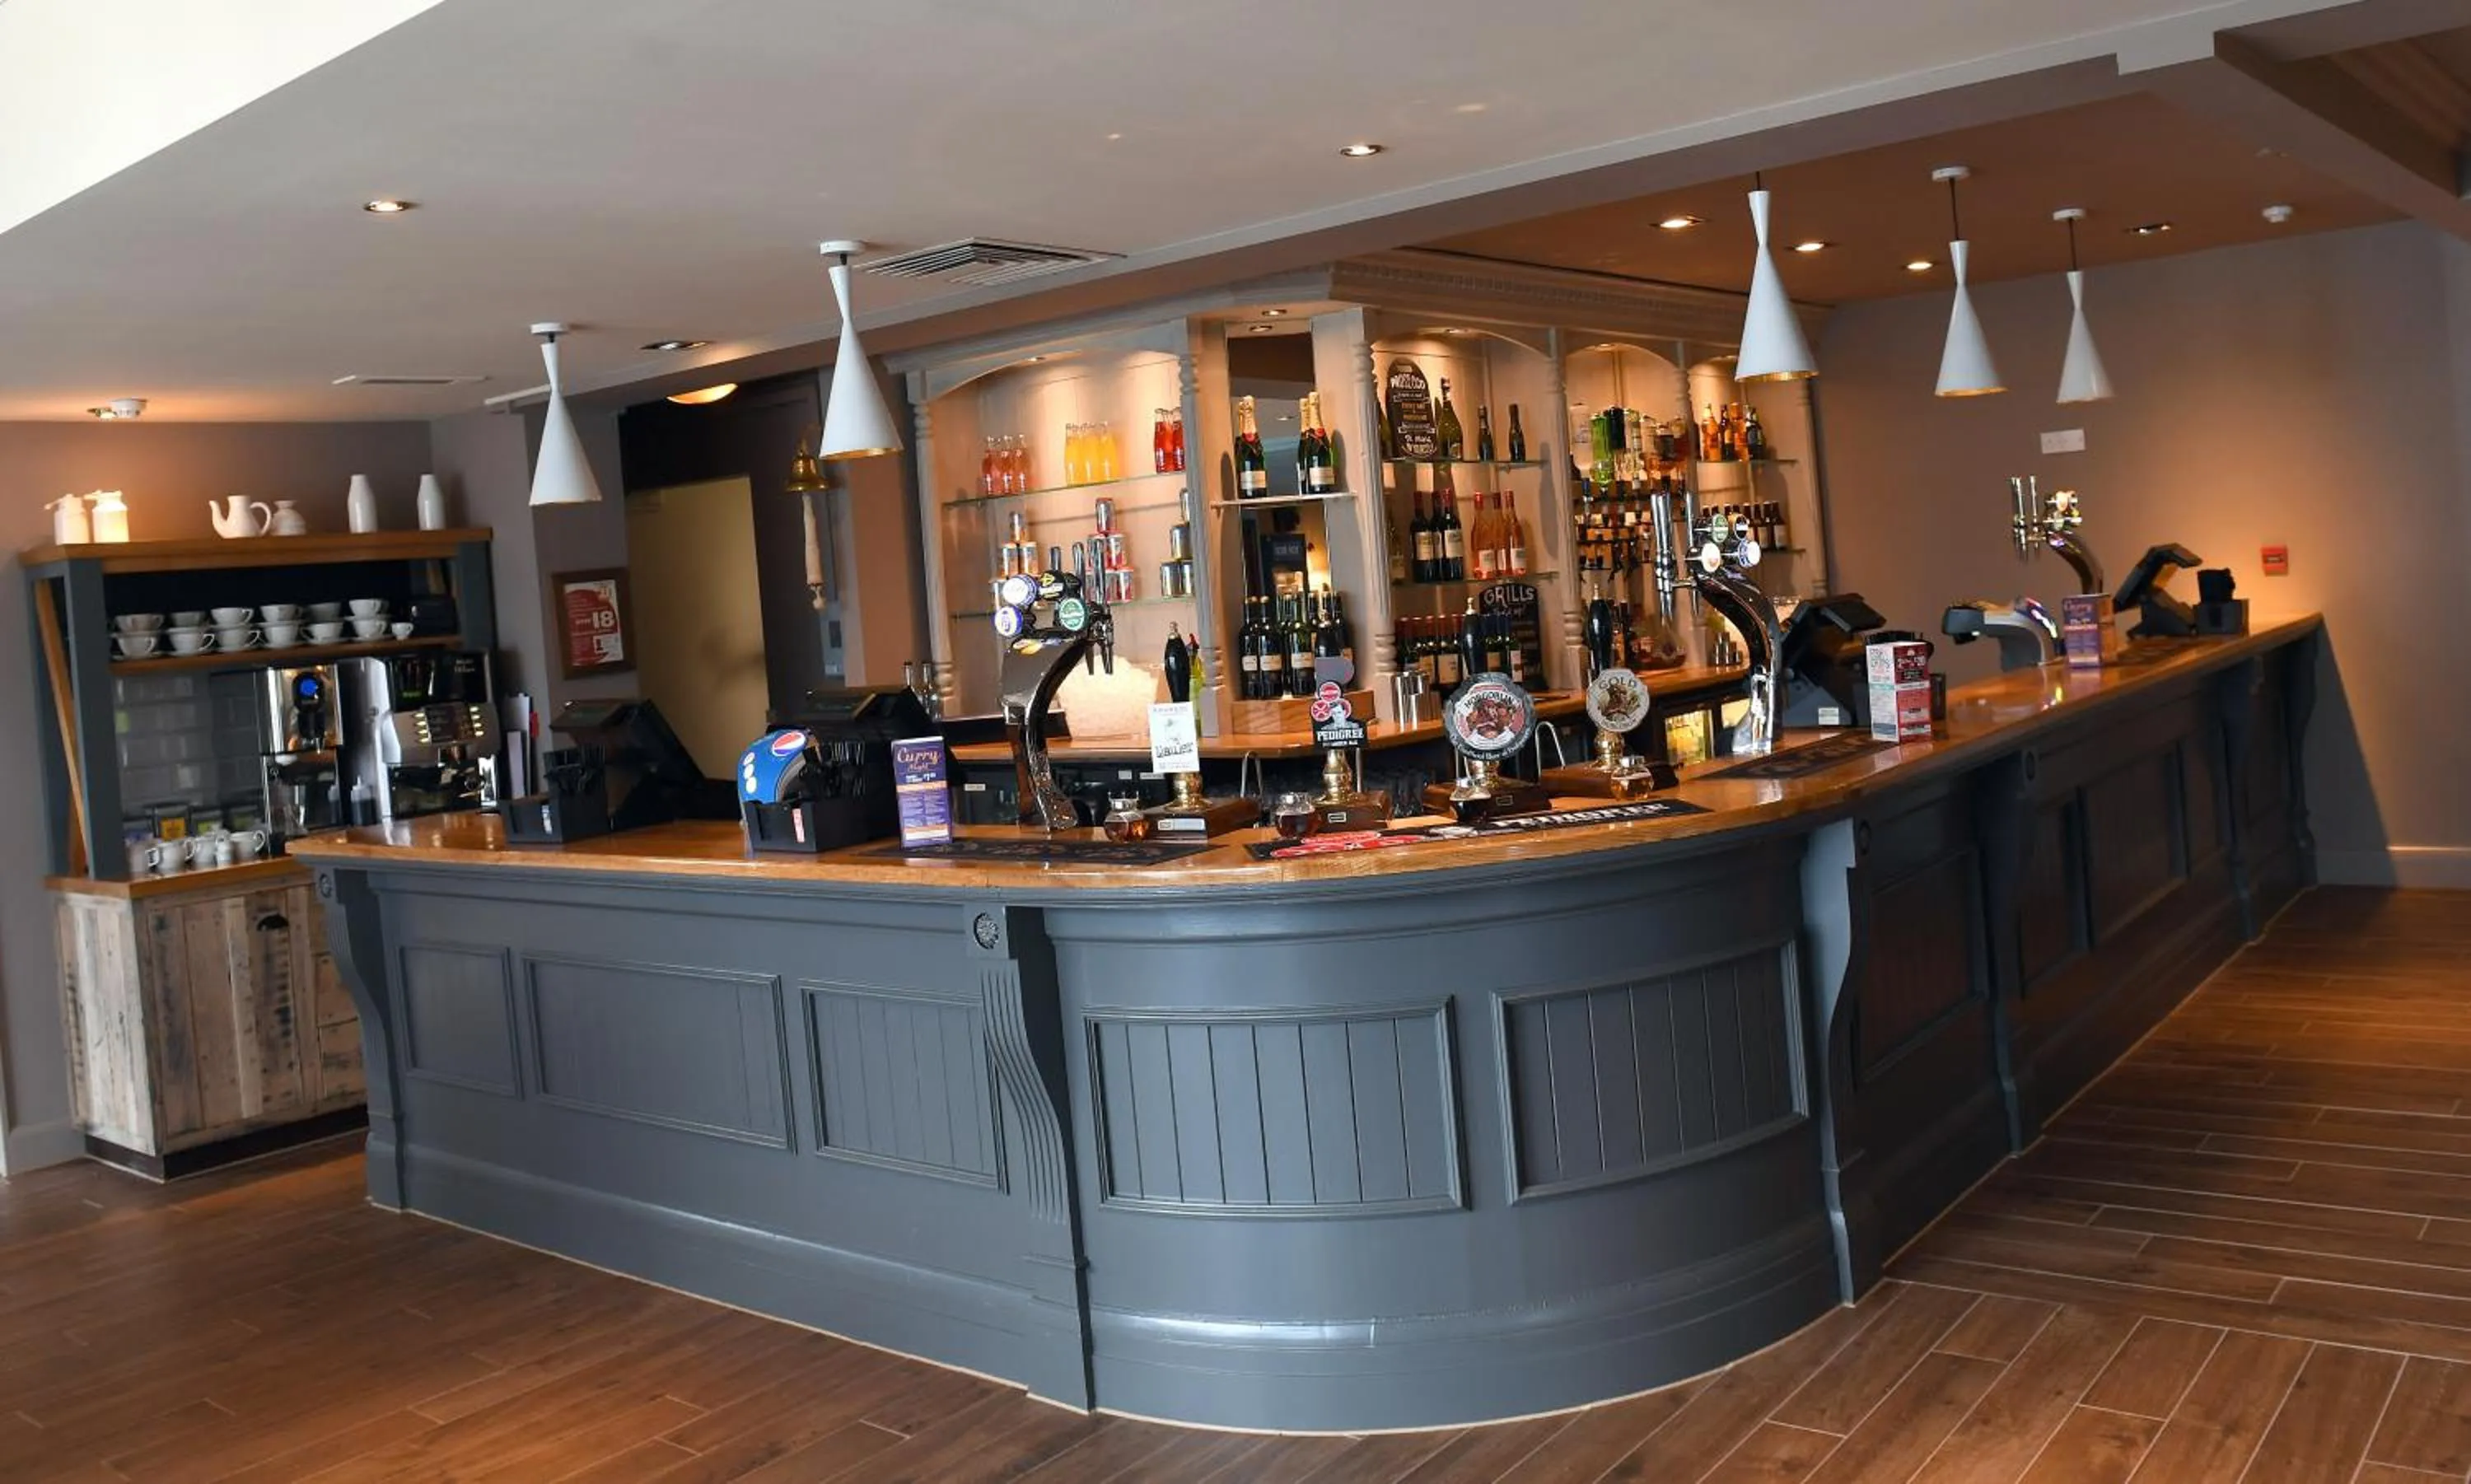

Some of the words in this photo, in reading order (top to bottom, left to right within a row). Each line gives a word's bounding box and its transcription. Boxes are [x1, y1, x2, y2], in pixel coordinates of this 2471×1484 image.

[1483, 586, 1534, 608] GRILLS
[593, 610, 614, 629] 18
[1599, 676, 1637, 690] GOLD
[1316, 728, 1365, 742] PEDIGREE
[897, 746, 939, 766] Curry
